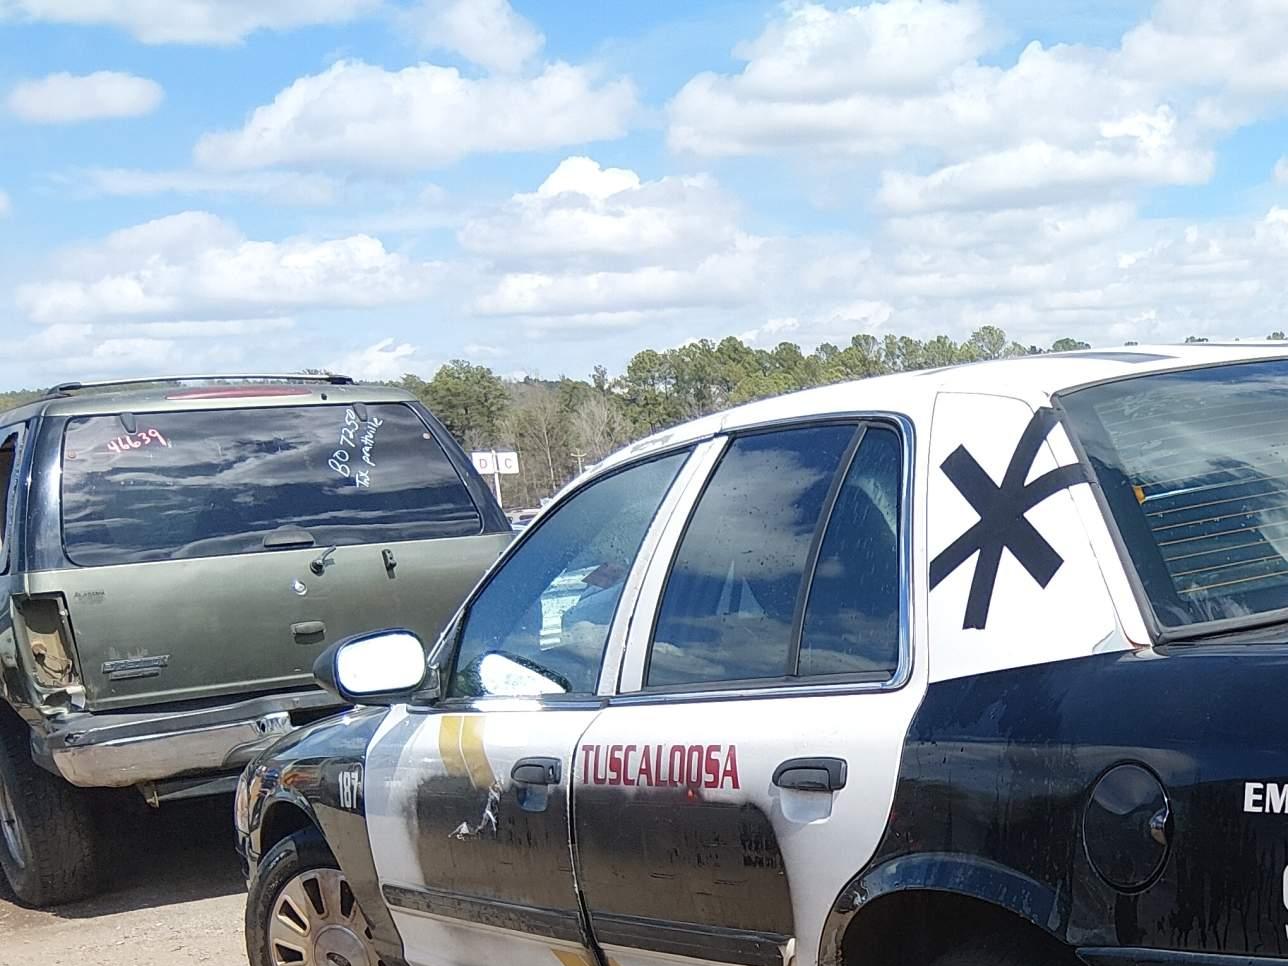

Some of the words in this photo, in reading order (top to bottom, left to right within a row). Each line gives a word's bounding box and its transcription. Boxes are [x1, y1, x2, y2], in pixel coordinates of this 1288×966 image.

[107, 428, 167, 453] 46639
[340, 408, 359, 448] 7250
[480, 458, 488, 469] D
[504, 458, 513, 470] C
[582, 744, 740, 789] TUSCALOOSA
[338, 769, 359, 809] 187
